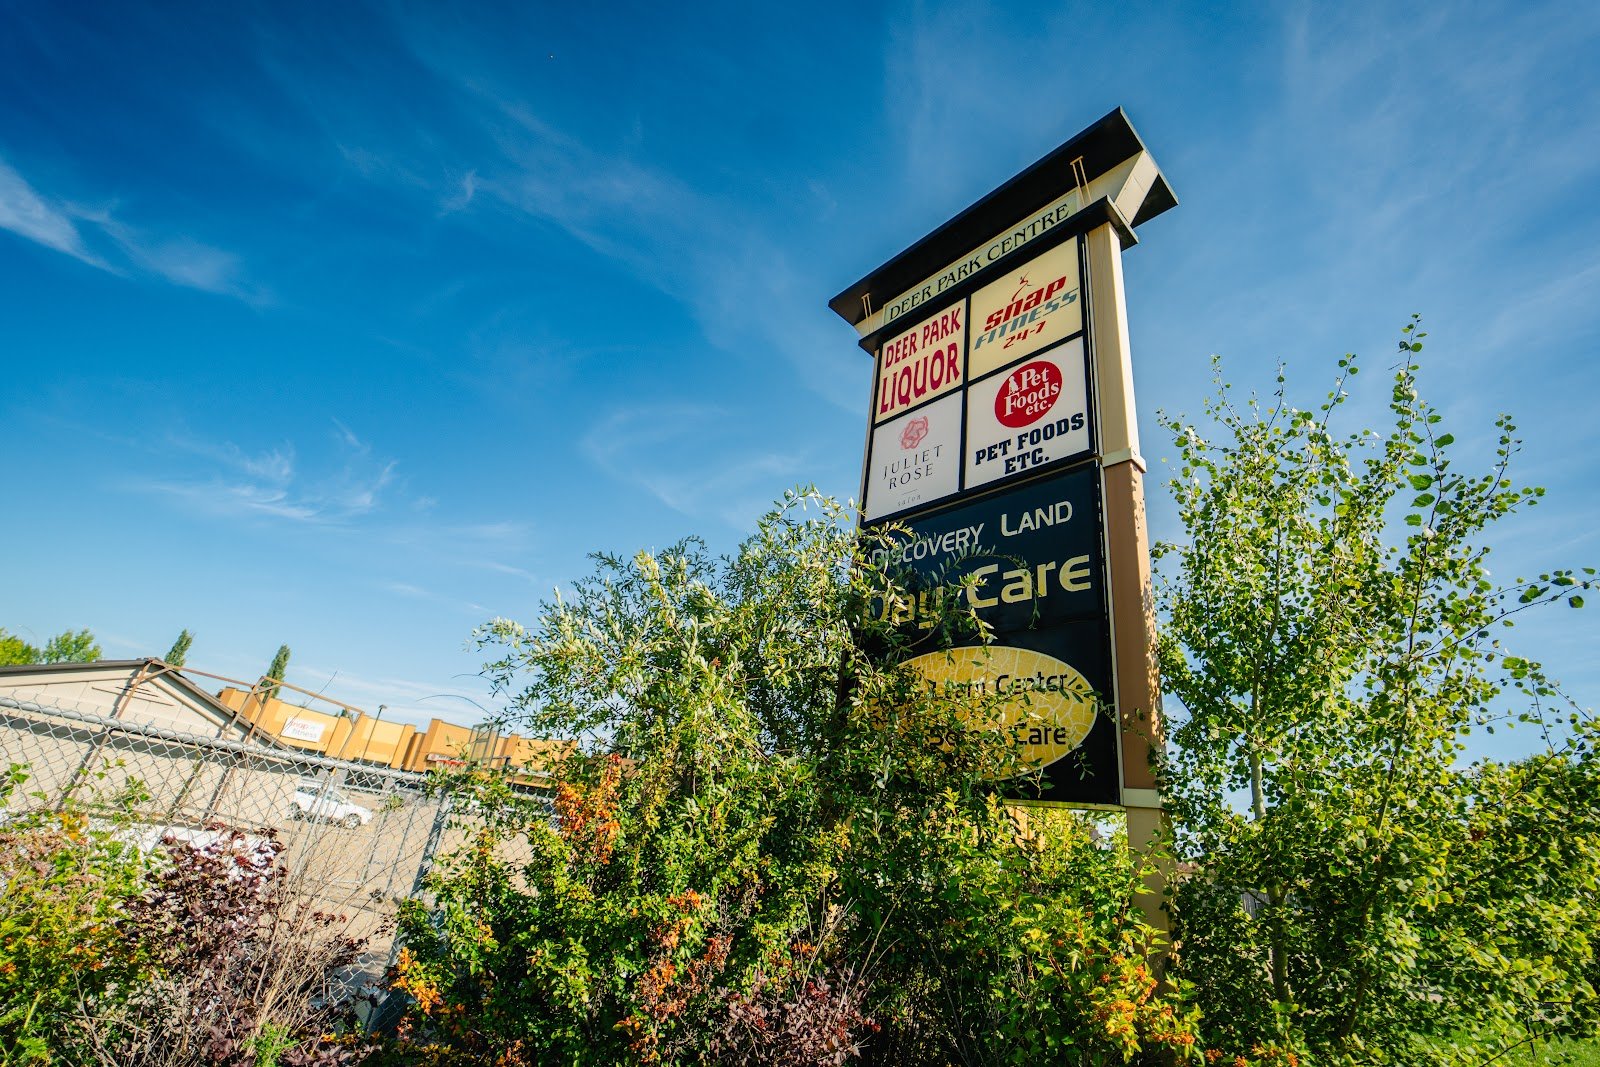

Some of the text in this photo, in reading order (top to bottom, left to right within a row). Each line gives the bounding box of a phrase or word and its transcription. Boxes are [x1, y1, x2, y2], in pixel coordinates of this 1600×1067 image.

[889, 203, 1069, 320] DEER PARK CENTRE
[984, 276, 1067, 331] snap
[885, 307, 961, 369] DEER PARK
[1003, 320, 1046, 349] 24-7
[880, 342, 960, 414] LIQUOR
[1020, 367, 1050, 392] Pet
[1003, 381, 1060, 418] Foods
[1025, 400, 1052, 416] etc.
[975, 412, 1085, 466] PET FOODS
[883, 444, 943, 480] JULIET
[889, 463, 933, 490] ROSE
[1004, 447, 1050, 475] ETC.
[1000, 500, 1073, 537] LAND
[966, 554, 1092, 609] Care
